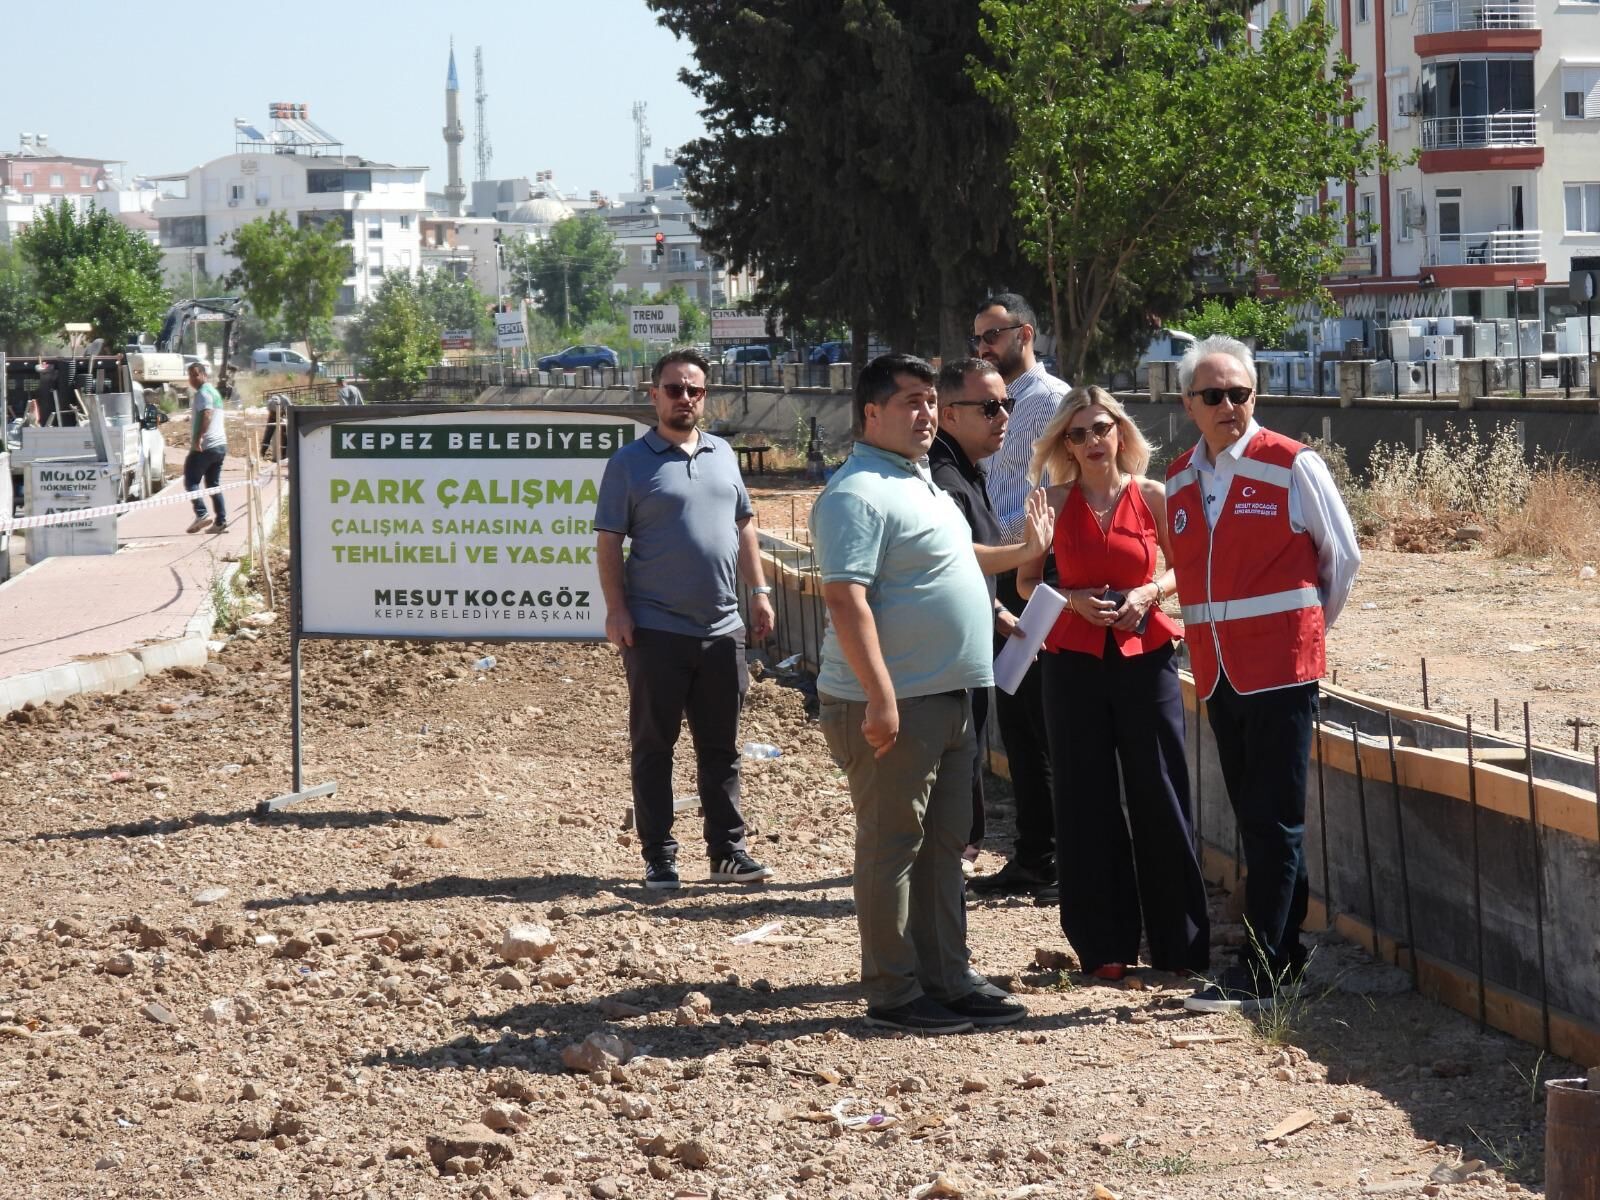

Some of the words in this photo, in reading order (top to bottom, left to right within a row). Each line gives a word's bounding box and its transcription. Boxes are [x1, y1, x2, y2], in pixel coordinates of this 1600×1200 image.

[633, 310, 664, 320] TREND
[633, 323, 648, 334] OTO
[649, 323, 677, 334] YIKAMA
[341, 433, 433, 450] KEPEZ
[448, 428, 624, 450] BELEDİYESİ
[40, 470, 96, 481] MOLOZ
[330, 479, 424, 504] PARK
[331, 519, 425, 537] ÇALIŞMA
[432, 519, 543, 534] SAHASINA
[332, 541, 456, 564] TEHLİKELİ
[465, 546, 498, 564] VE
[374, 589, 459, 607] MESUT
[465, 587, 590, 607] KOCAGÖZ
[374, 608, 424, 619] KEPEZ
[430, 607, 511, 620] BELEDİYE
[517, 610, 590, 622] BAŞKANI
